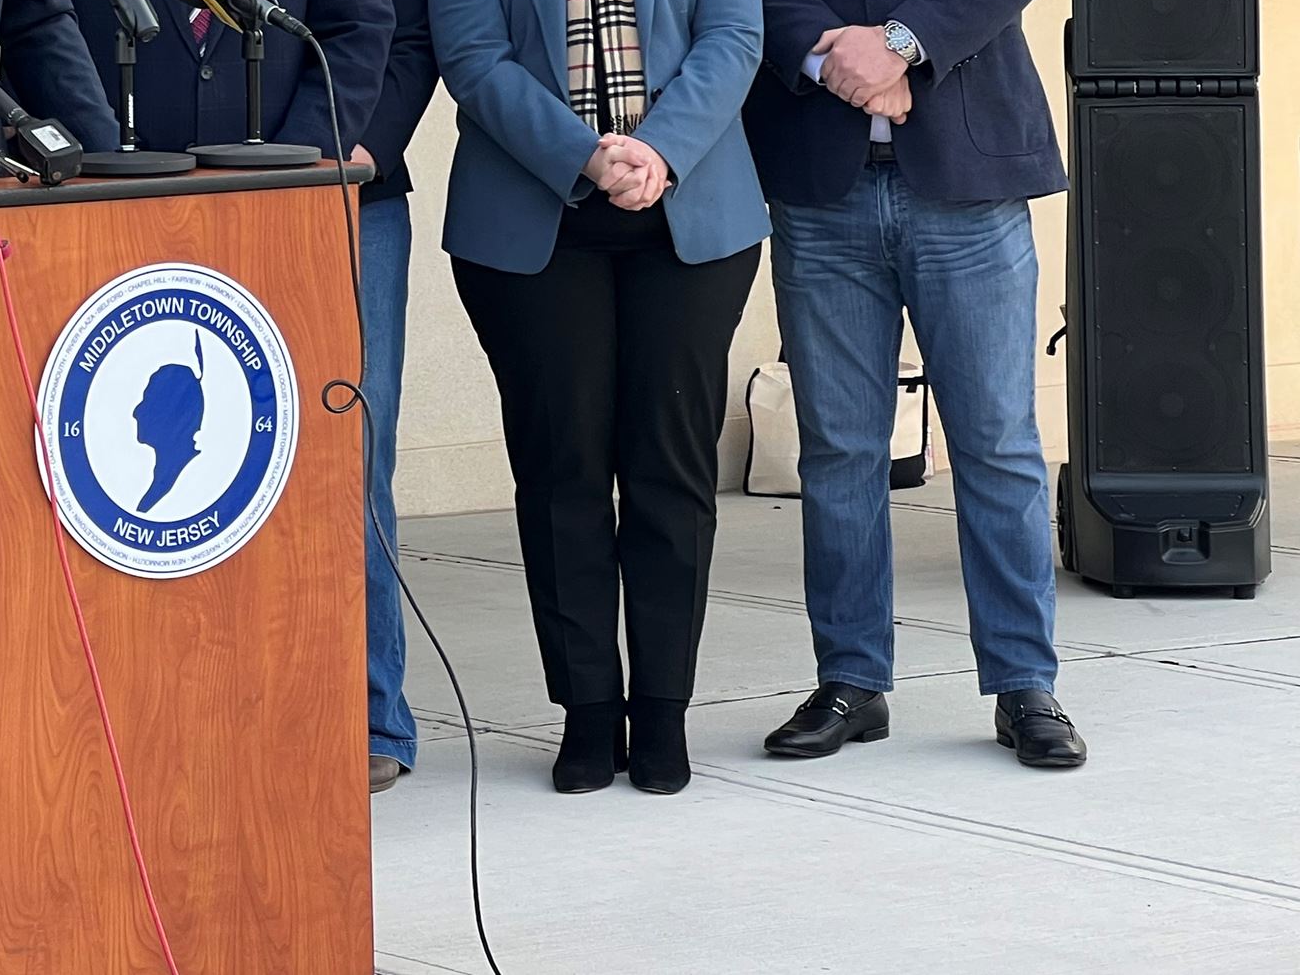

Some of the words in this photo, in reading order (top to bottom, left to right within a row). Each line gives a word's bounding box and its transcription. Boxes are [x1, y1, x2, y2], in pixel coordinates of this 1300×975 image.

[78, 296, 184, 374] MIDDLETOWN
[188, 298, 262, 371] TOWNSHIP
[63, 420, 80, 437] 16
[255, 415, 273, 432] 64
[113, 516, 154, 545] NEW
[156, 510, 220, 547] JERSEY
